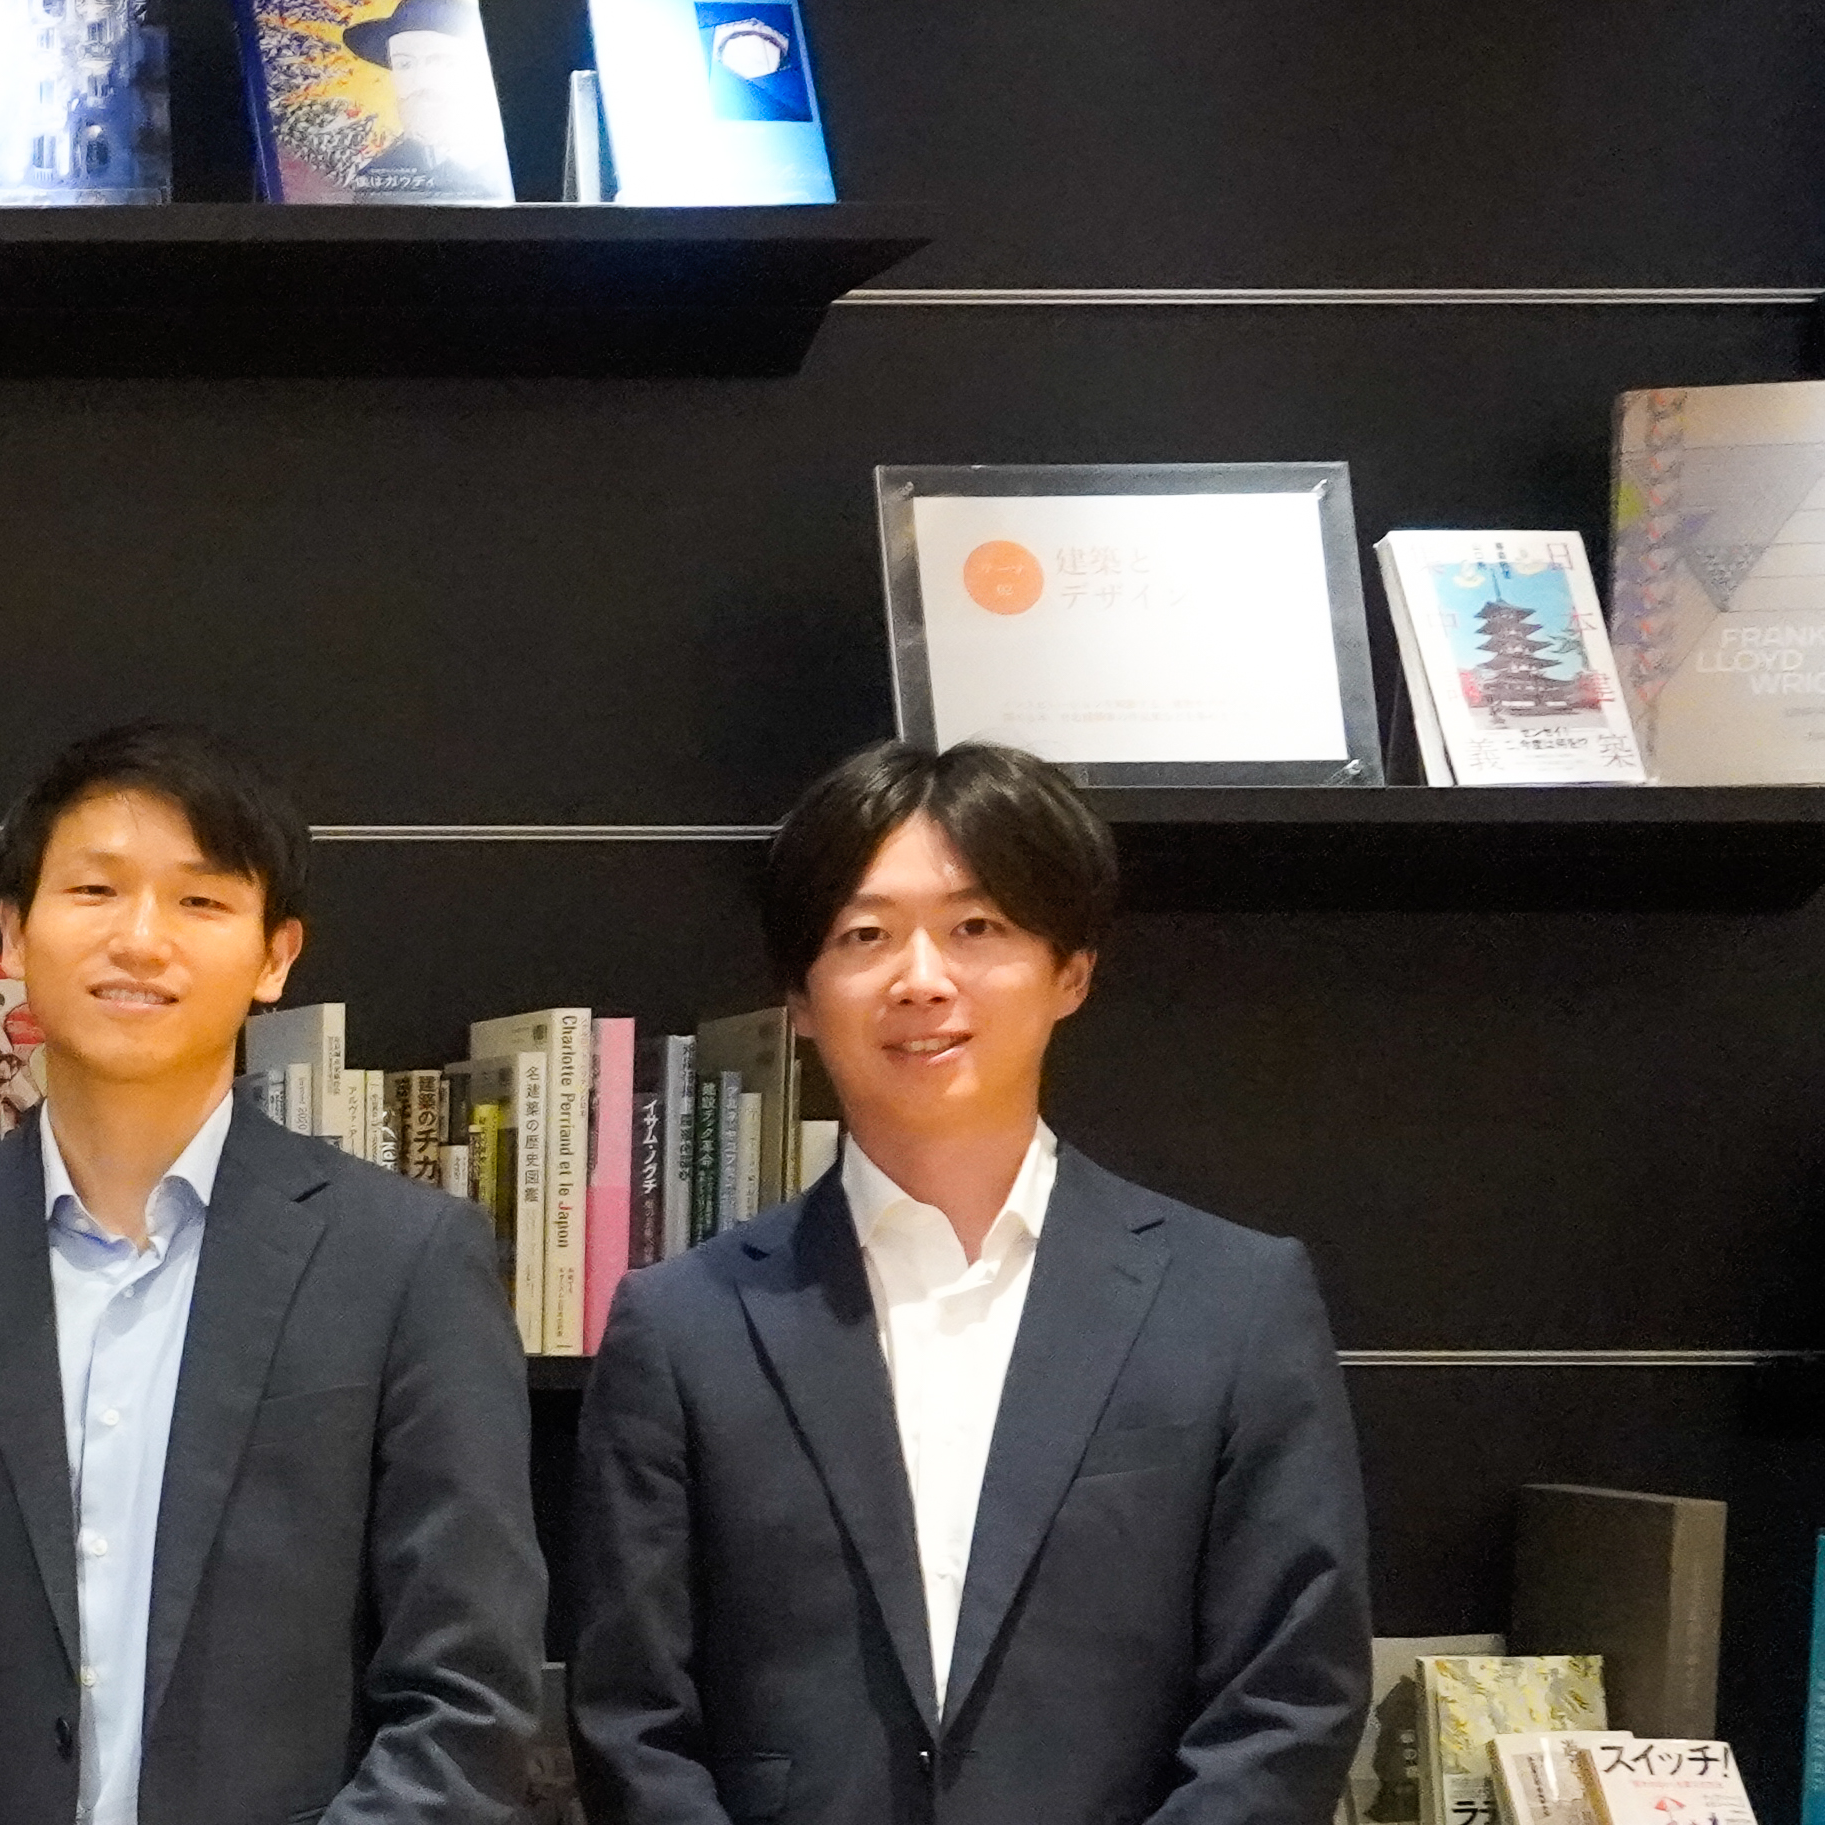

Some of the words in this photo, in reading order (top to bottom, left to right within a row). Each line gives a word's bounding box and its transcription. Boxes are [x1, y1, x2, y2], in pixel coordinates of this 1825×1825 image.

[1056, 545, 1151, 577] 建築と
[1696, 649, 1803, 674] LLOYD
[561, 1015, 578, 1087] Charlotte
[558, 1092, 576, 1157] Perriand
[642, 1099, 660, 1195] イサム・ノグチ
[558, 1160, 573, 1176] et
[557, 1182, 573, 1197] le
[553, 1201, 573, 1249] Japon
[1600, 1743, 1731, 1778] スイッチ!
